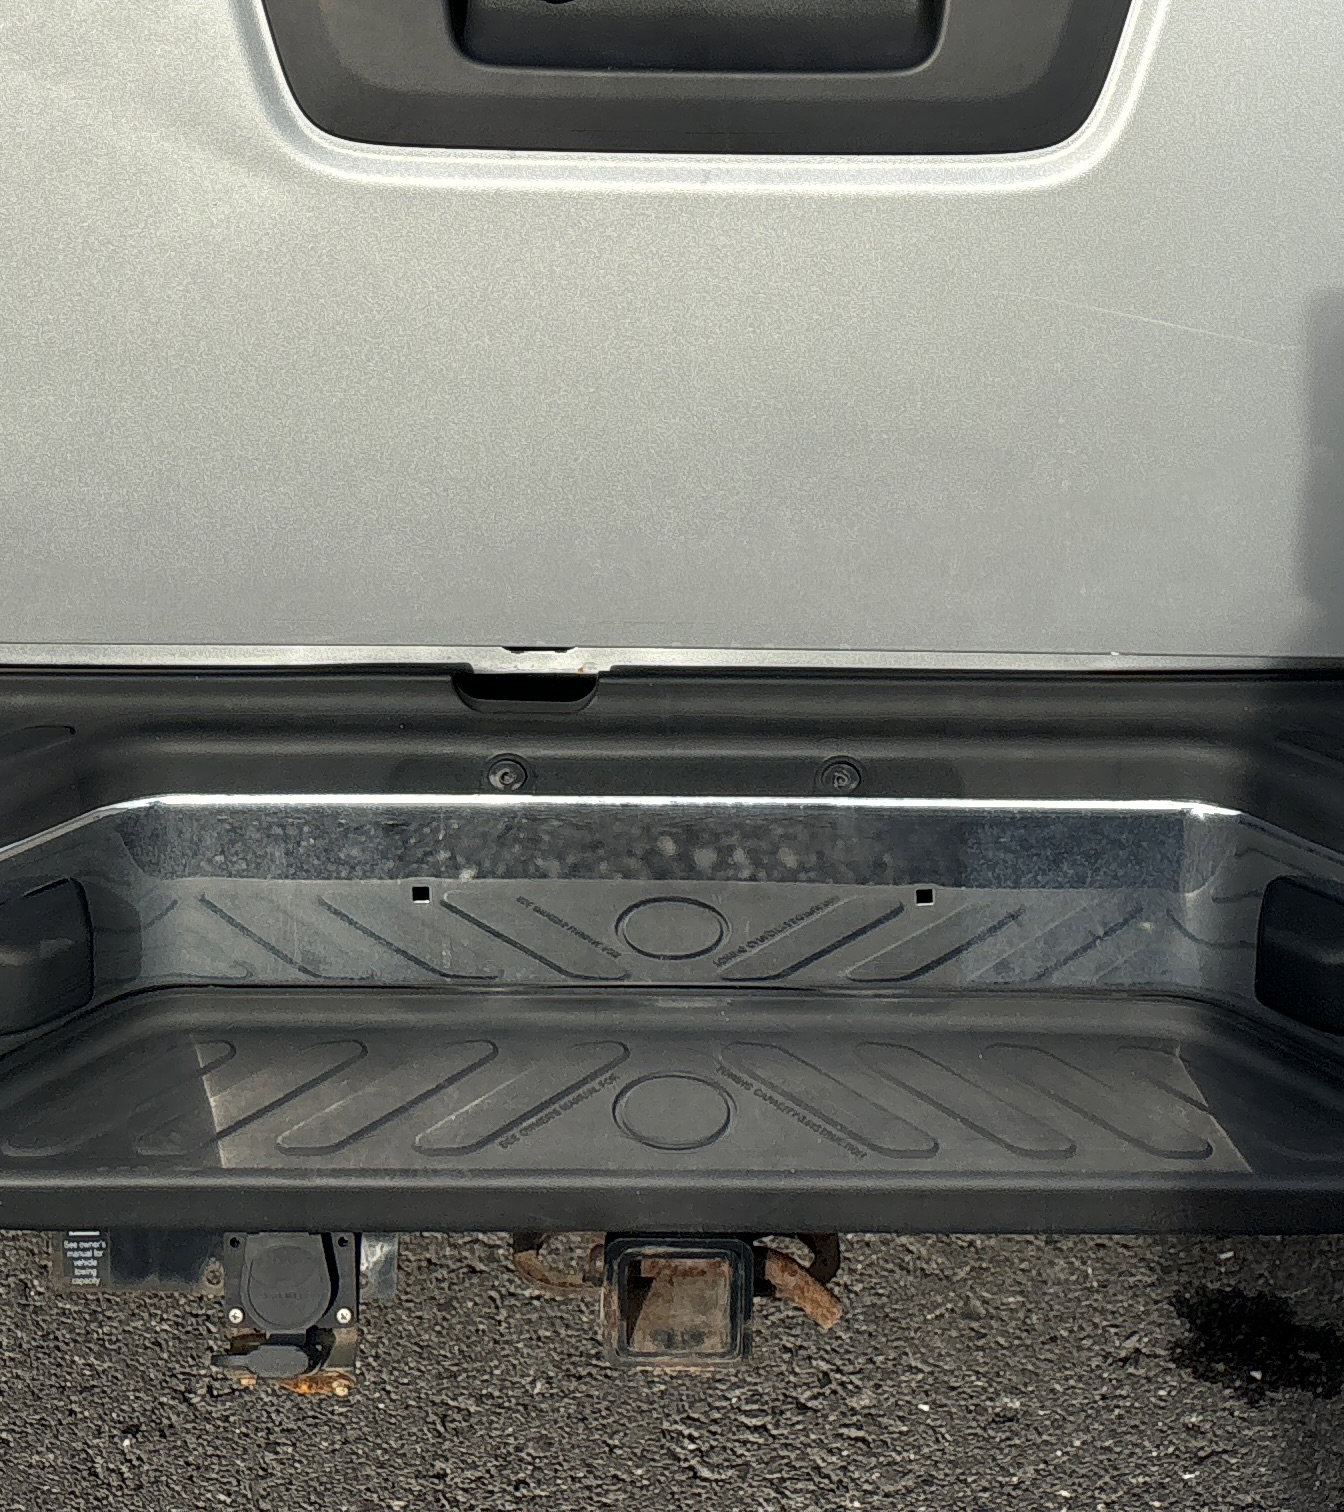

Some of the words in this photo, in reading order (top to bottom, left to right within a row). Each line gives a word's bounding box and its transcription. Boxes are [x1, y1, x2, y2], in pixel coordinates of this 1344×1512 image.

[63, 1240, 78, 1249] See
[78, 1240, 106, 1249] owner's
[66, 1249, 93, 1258] manual
[93, 1249, 104, 1257] for
[72, 1258, 98, 1267] vehicle
[74, 1268, 97, 1277] towing
[71, 1277, 101, 1287] capacity
